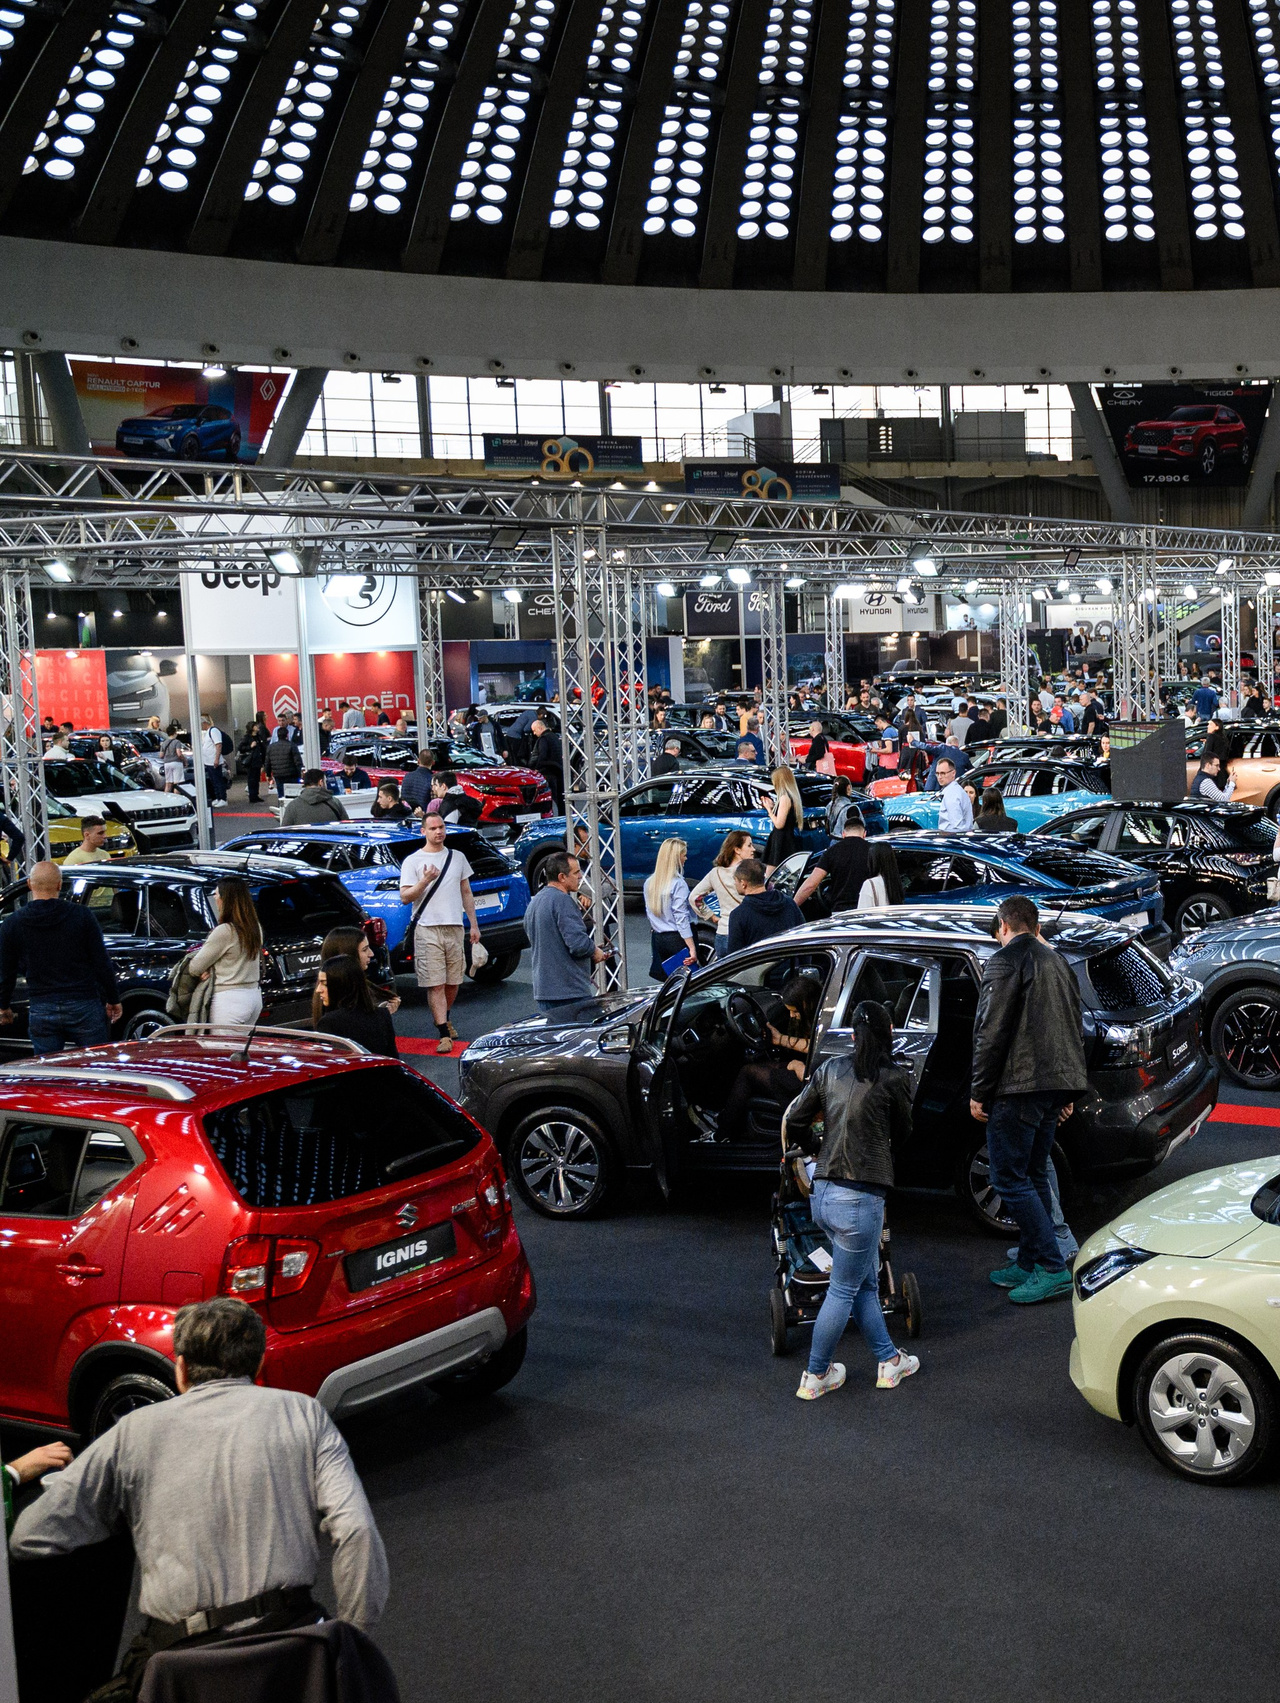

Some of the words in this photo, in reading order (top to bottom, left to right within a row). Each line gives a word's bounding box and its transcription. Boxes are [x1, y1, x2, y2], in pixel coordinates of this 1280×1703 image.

[87, 377, 126, 386] RENAULT
[127, 380, 160, 388] CAPTUR
[1143, 475, 1180, 483] 17.990
[694, 592, 732, 613] Ford
[376, 1239, 428, 1271] IGNIS
